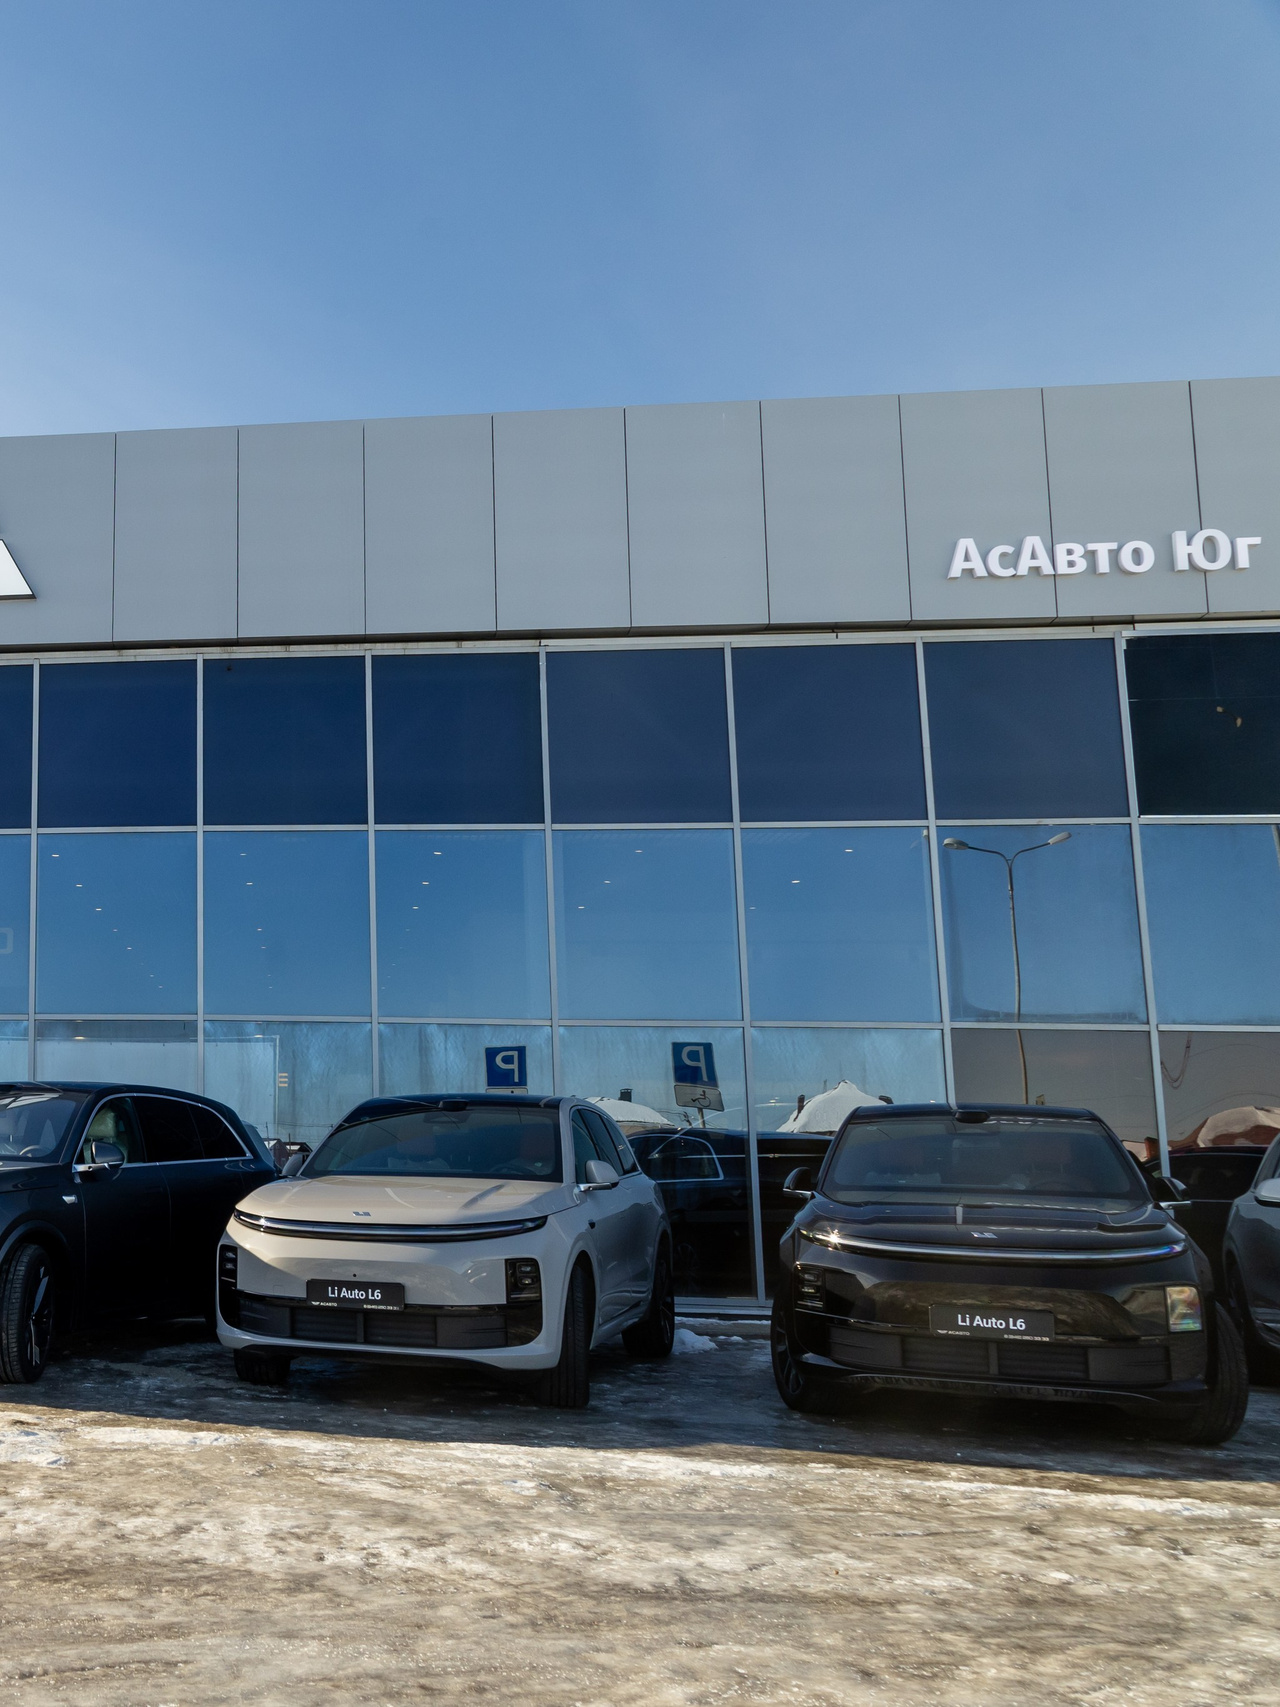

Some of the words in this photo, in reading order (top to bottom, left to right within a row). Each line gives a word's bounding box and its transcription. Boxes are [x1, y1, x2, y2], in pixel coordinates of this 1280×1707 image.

[947, 535, 1156, 579] АсАвто
[1171, 528, 1262, 573] Юг
[328, 1286, 338, 1298] Li
[340, 1287, 366, 1299] Auto
[368, 1289, 382, 1300] L6
[957, 1314, 970, 1326] Li
[973, 1315, 1006, 1329] Auto
[1008, 1317, 1026, 1330] L6
